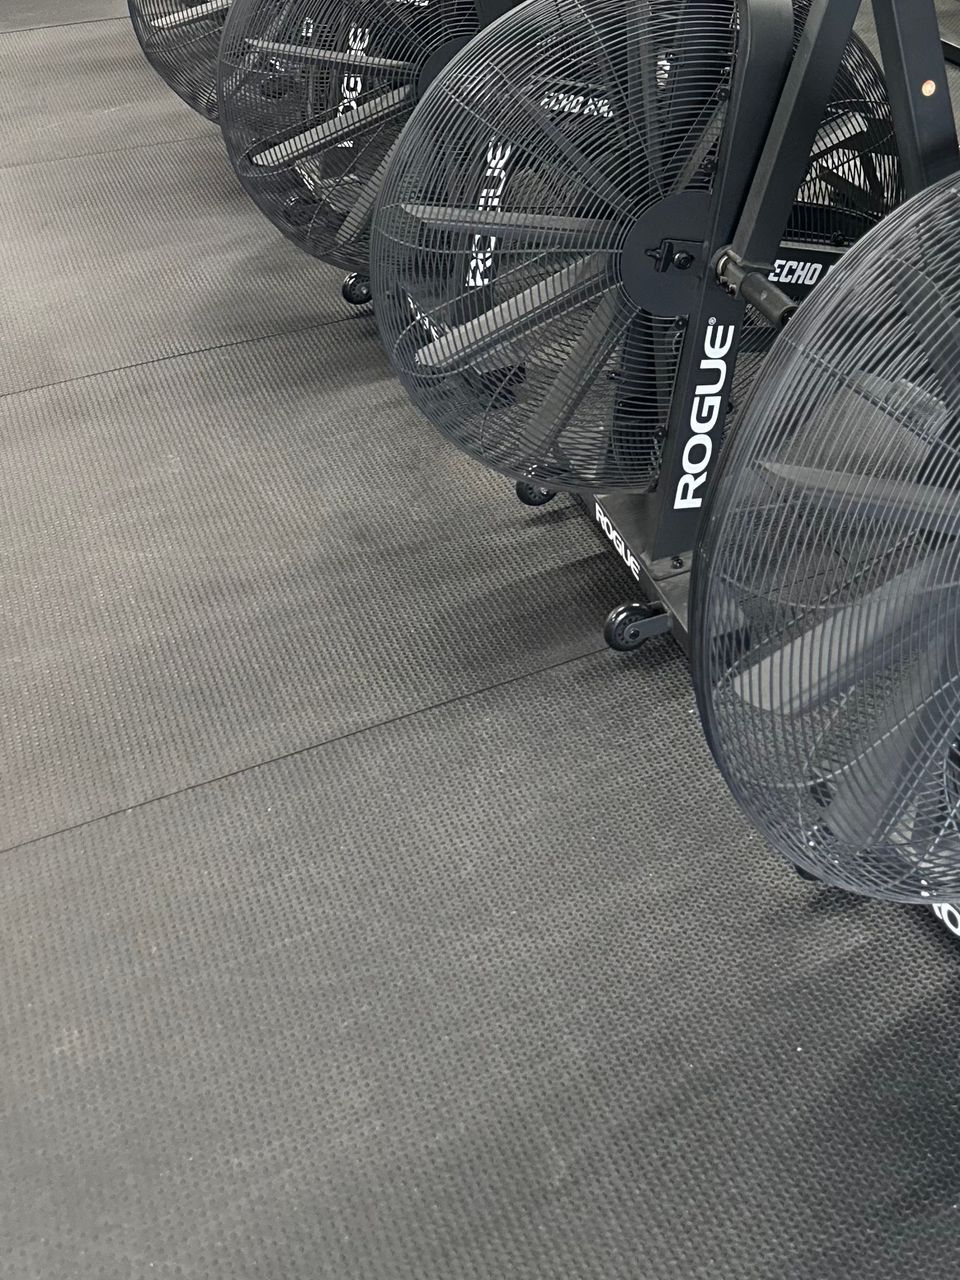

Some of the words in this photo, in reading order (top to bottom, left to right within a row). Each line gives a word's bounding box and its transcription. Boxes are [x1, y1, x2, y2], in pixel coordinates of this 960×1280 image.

[767, 258, 823, 286] ECHO
[673, 323, 735, 510] ROGUE
[595, 501, 641, 582] ROGUE
